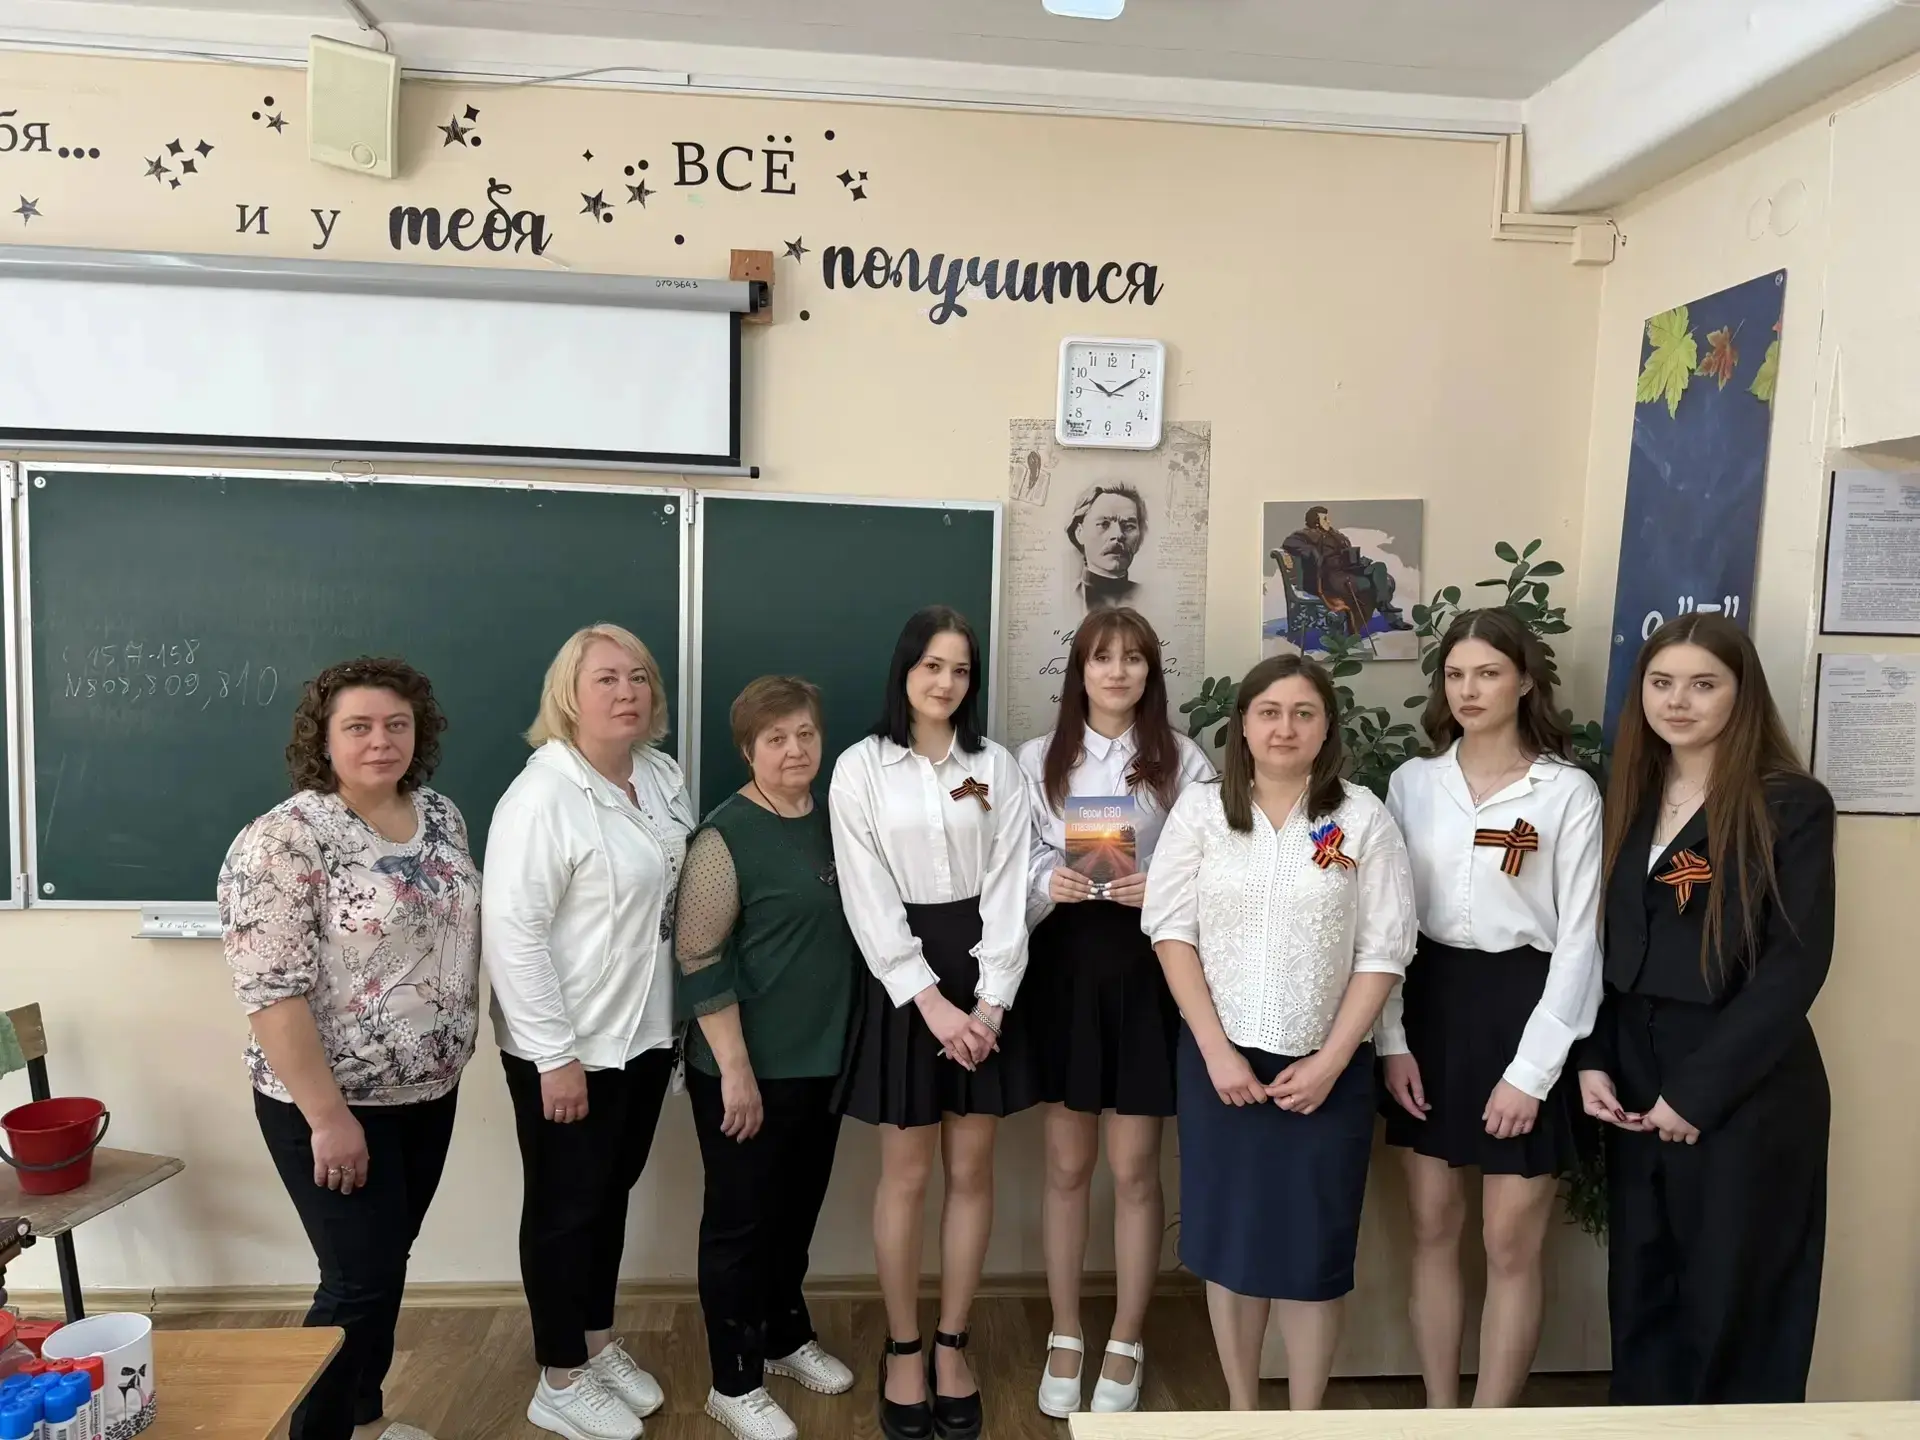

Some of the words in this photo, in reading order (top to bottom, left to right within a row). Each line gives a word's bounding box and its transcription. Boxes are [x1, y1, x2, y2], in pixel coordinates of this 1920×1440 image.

[671, 134, 797, 196] ВСЁ
[236, 204, 270, 236] и
[311, 208, 341, 250] у
[389, 177, 553, 256] тебя
[822, 244, 1165, 325] получится
[1090, 355, 1097, 367] 11
[1107, 357, 1117, 367] 12
[1131, 359, 1135, 369] 1
[1077, 367, 1087, 378] 10
[1139, 368, 1146, 379] 2
[1075, 387, 1082, 398] 9
[1138, 391, 1145, 402] 3
[1075, 408, 1082, 418] 8
[1137, 409, 1144, 420] 4
[1086, 419, 1092, 430] 7
[1104, 421, 1112, 432] 6
[1125, 422, 1132, 432] 5
[1103, 806, 1122, 818] СВО
